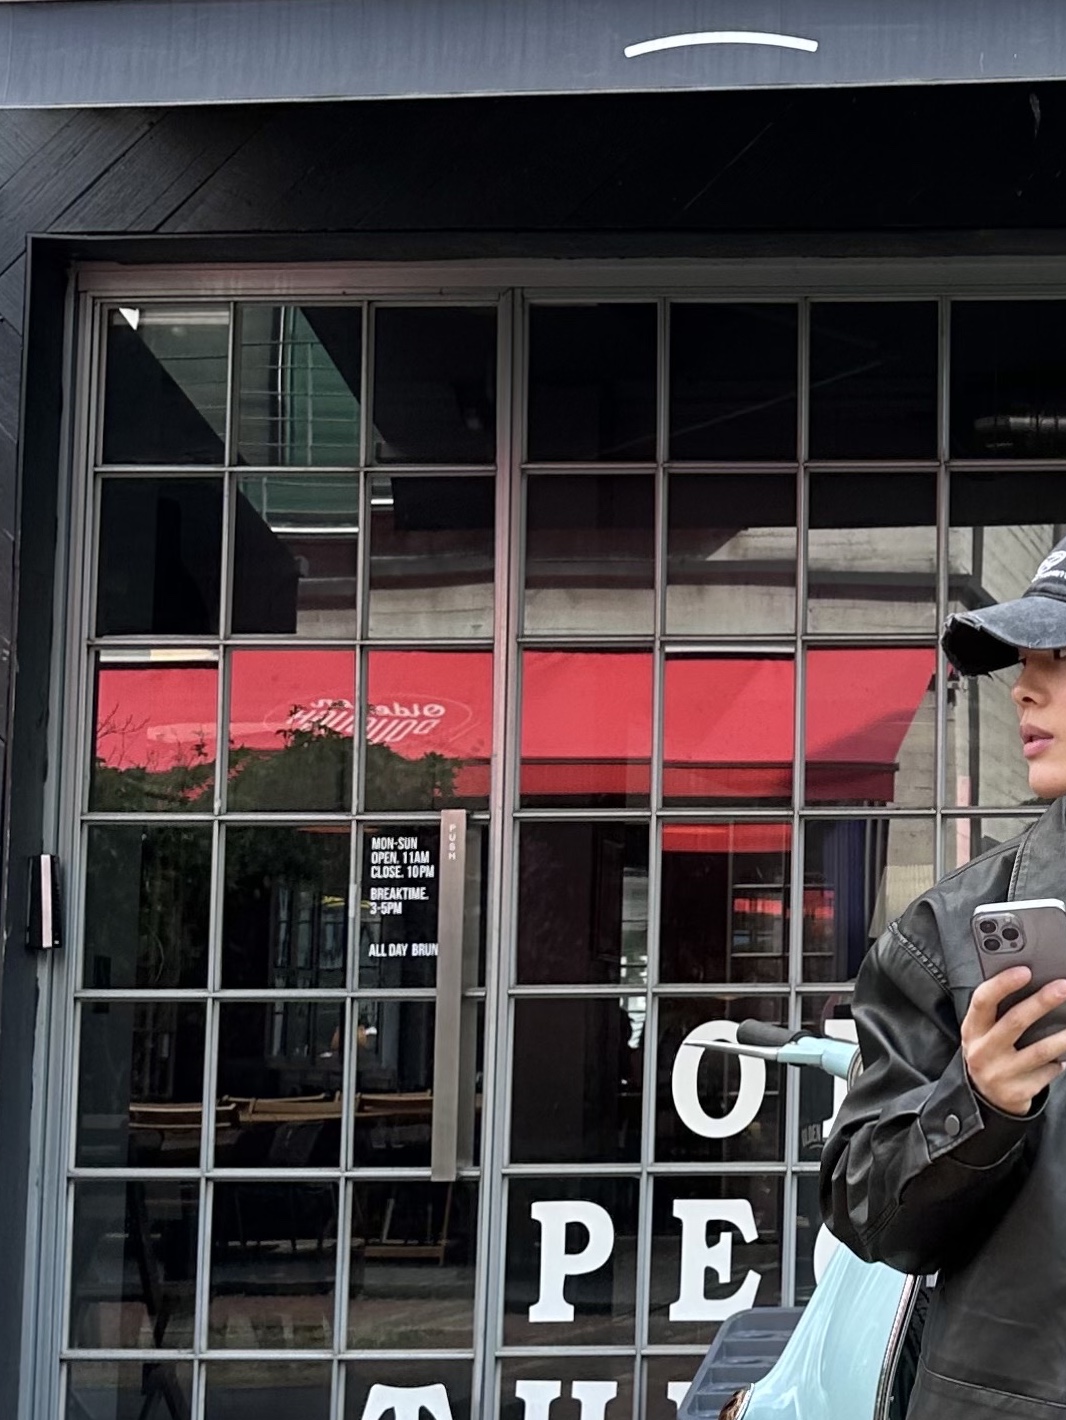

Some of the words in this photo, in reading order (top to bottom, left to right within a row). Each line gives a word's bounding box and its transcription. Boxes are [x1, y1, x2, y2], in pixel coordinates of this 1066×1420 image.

[371, 836, 418, 850] MON-SUN
[402, 850, 430, 864] 11AM
[407, 864, 435, 878] 10PM
[369, 901, 403, 915] 3-5PM
[368, 943, 387, 957] ALL
[388, 943, 409, 957] DAY
[411, 943, 440, 957] BRUN
